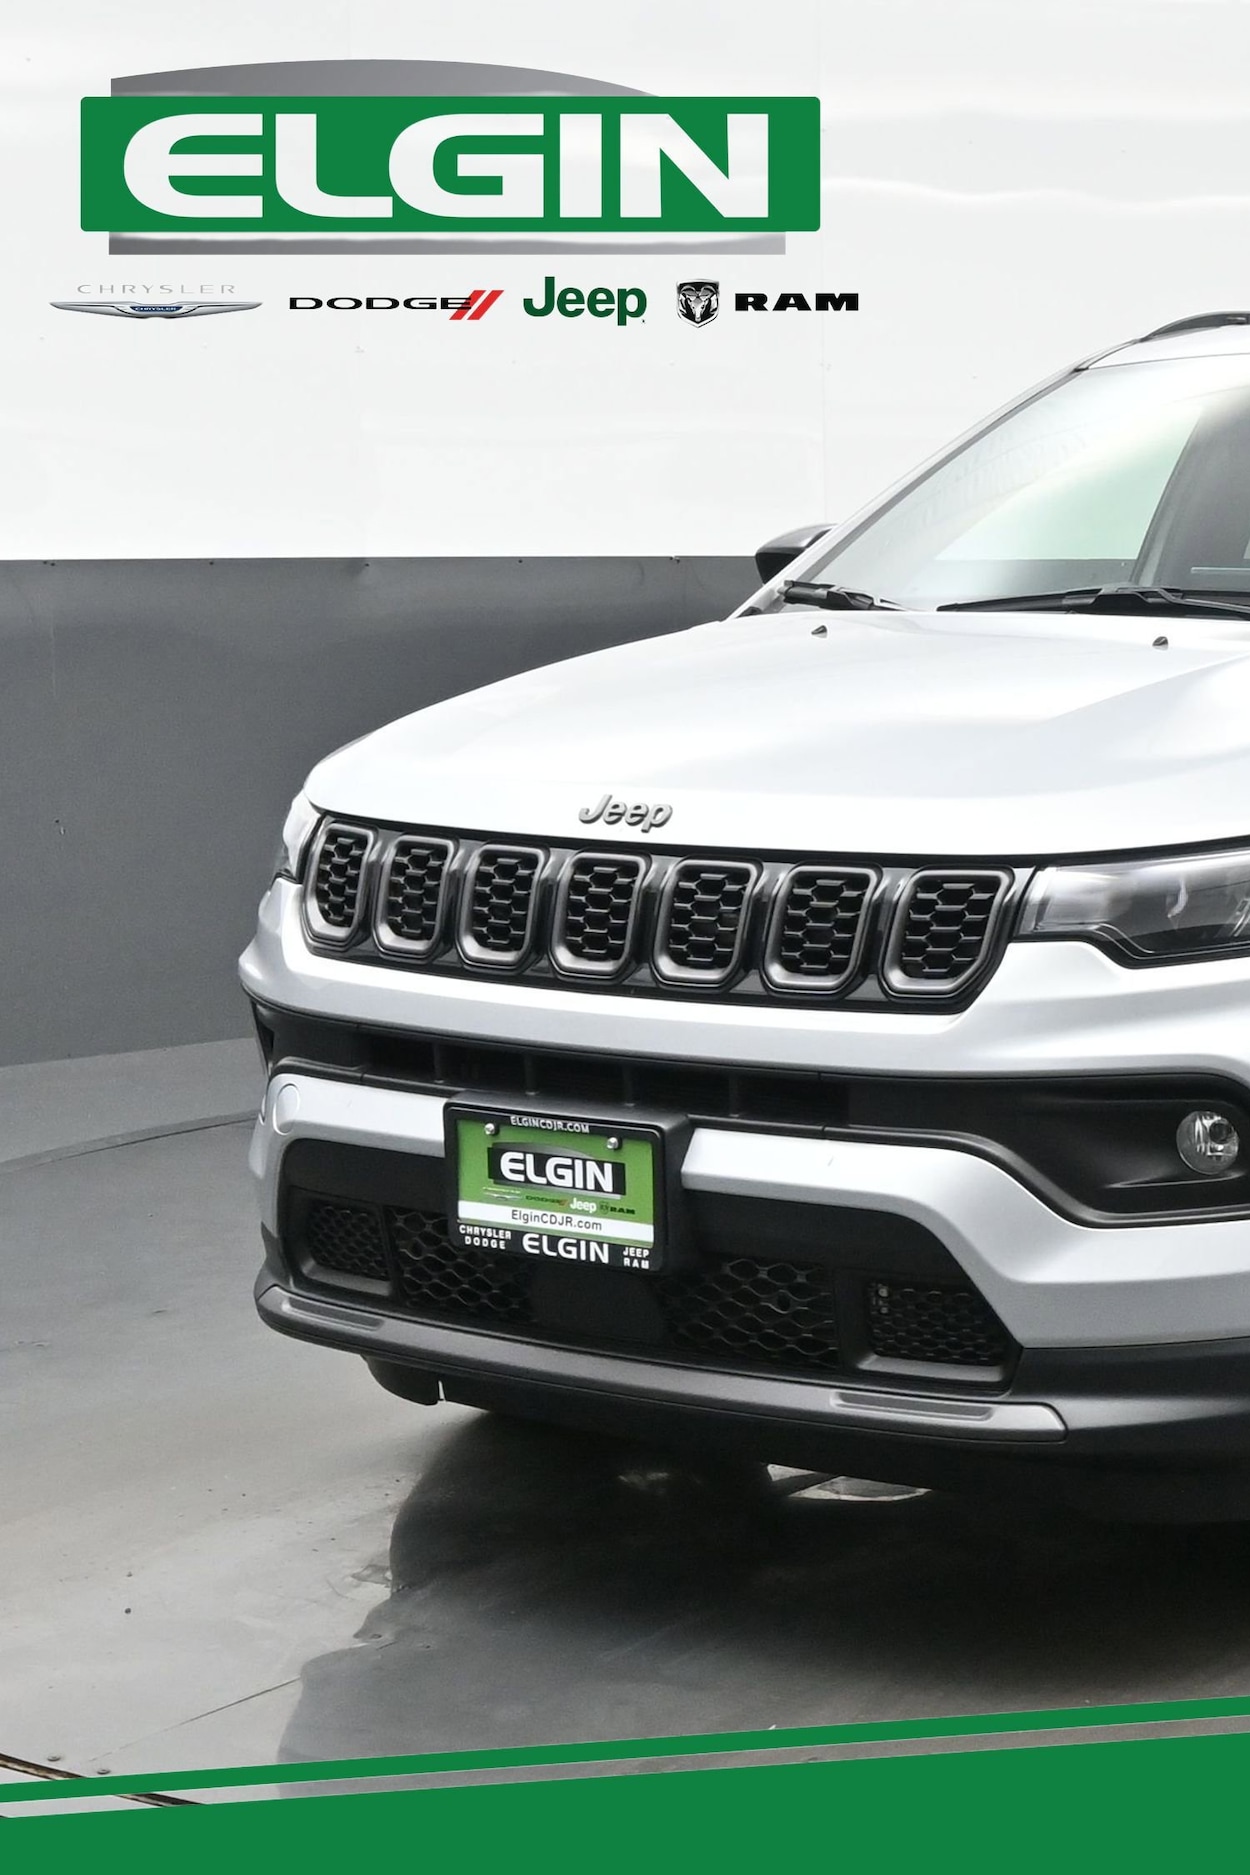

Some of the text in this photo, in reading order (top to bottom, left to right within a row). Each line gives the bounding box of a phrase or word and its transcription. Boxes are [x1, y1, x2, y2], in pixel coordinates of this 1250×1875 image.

[578, 793, 673, 833] Jeep
[510, 1116, 589, 1133] ELGINCDJR.COM
[500, 1151, 613, 1192] ELGIN
[570, 1198, 596, 1213] Jeep
[511, 1209, 602, 1230] ElginCDJR.com
[459, 1225, 511, 1239] CHRYSLER
[465, 1236, 505, 1249] DODGE
[522, 1233, 608, 1263] ELGIN
[623, 1247, 649, 1257] JEEP
[623, 1258, 649, 1269] RAM
